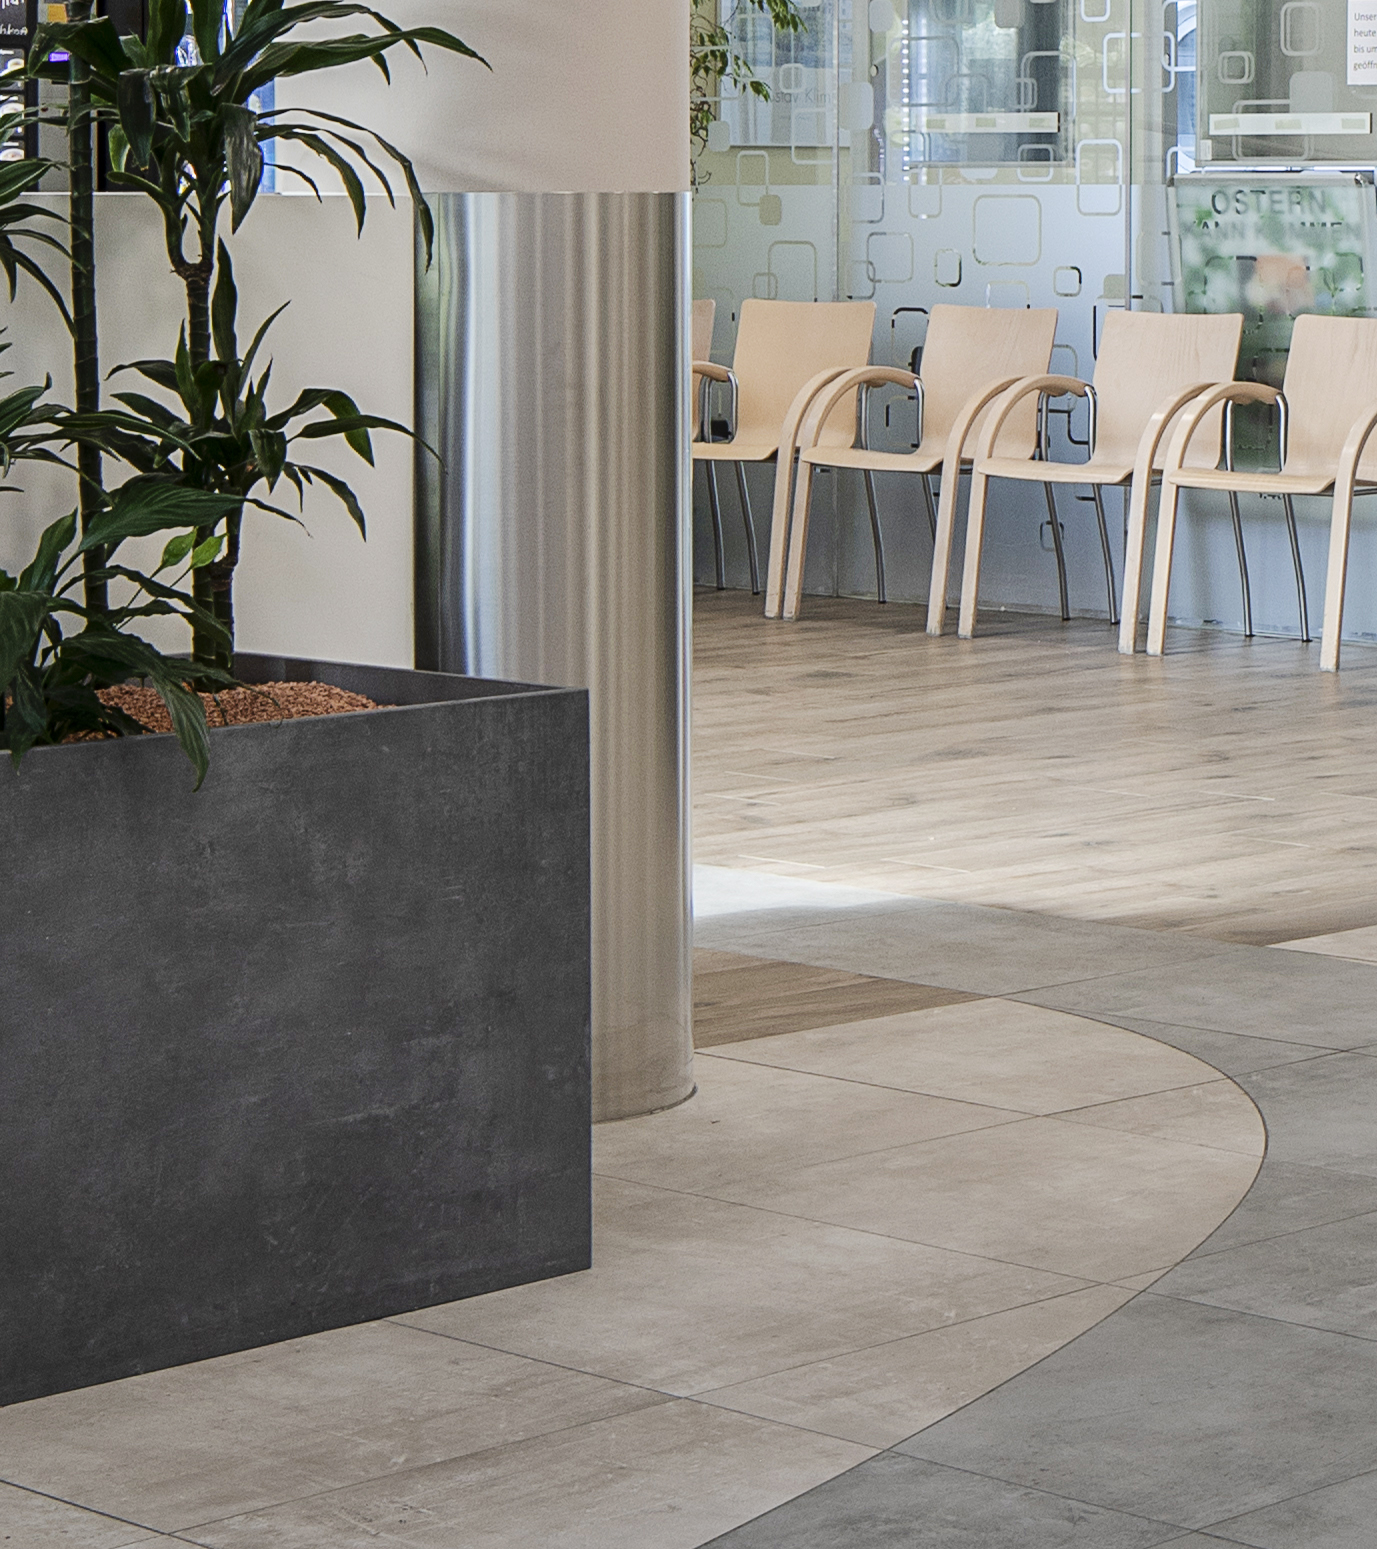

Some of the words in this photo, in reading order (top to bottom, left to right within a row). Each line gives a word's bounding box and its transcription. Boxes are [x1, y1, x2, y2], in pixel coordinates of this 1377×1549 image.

[1354, 29, 1376, 37] heute
[1354, 45, 1364, 53] bis
[1211, 189, 1327, 215] OSTERN
